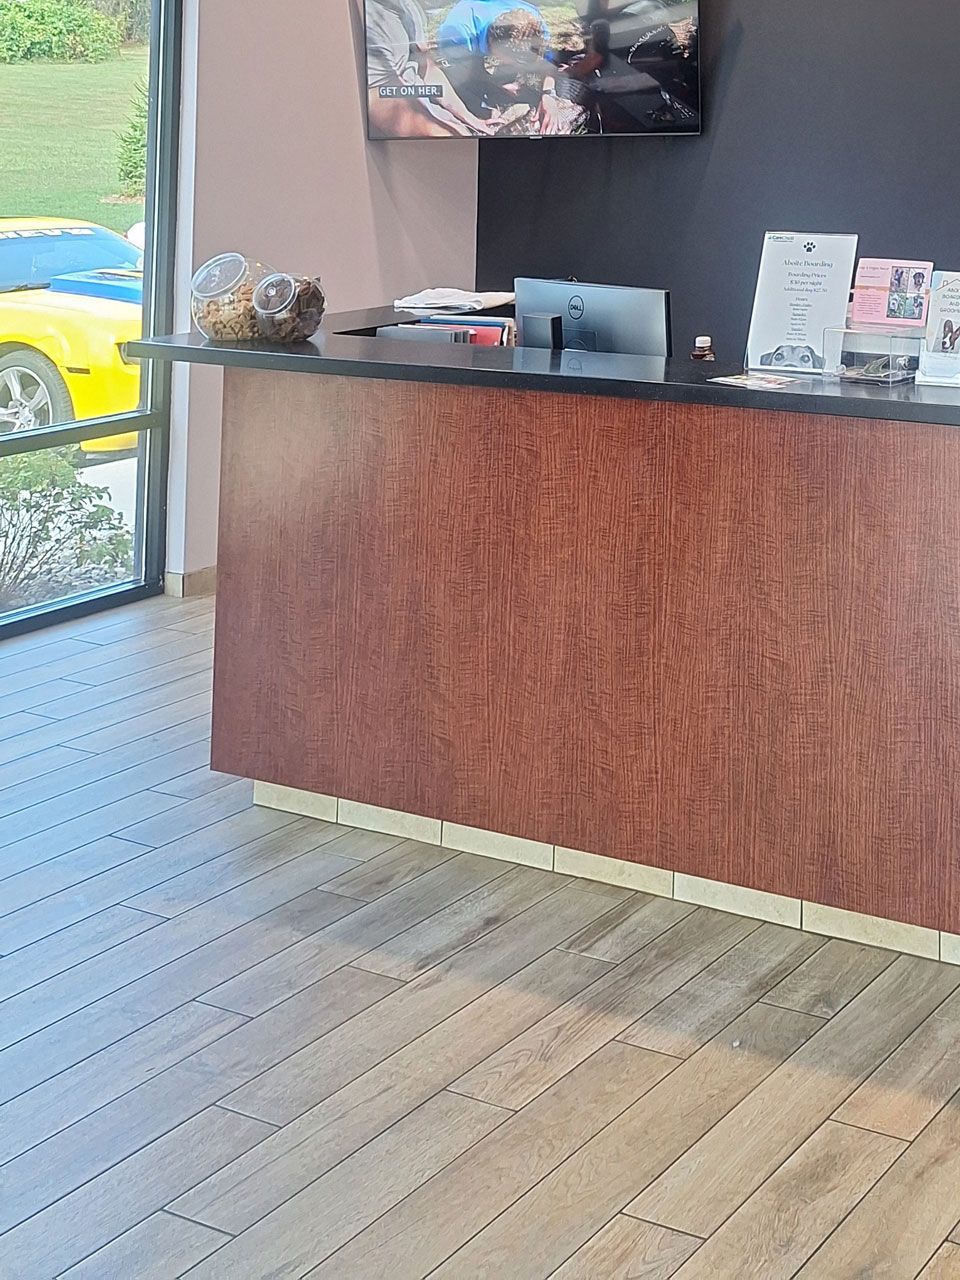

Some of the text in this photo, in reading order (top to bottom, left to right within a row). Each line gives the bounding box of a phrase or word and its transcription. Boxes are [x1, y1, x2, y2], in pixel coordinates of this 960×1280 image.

[380, 86, 440, 96] GET ON HER.
[803, 260, 834, 268] Boarding
